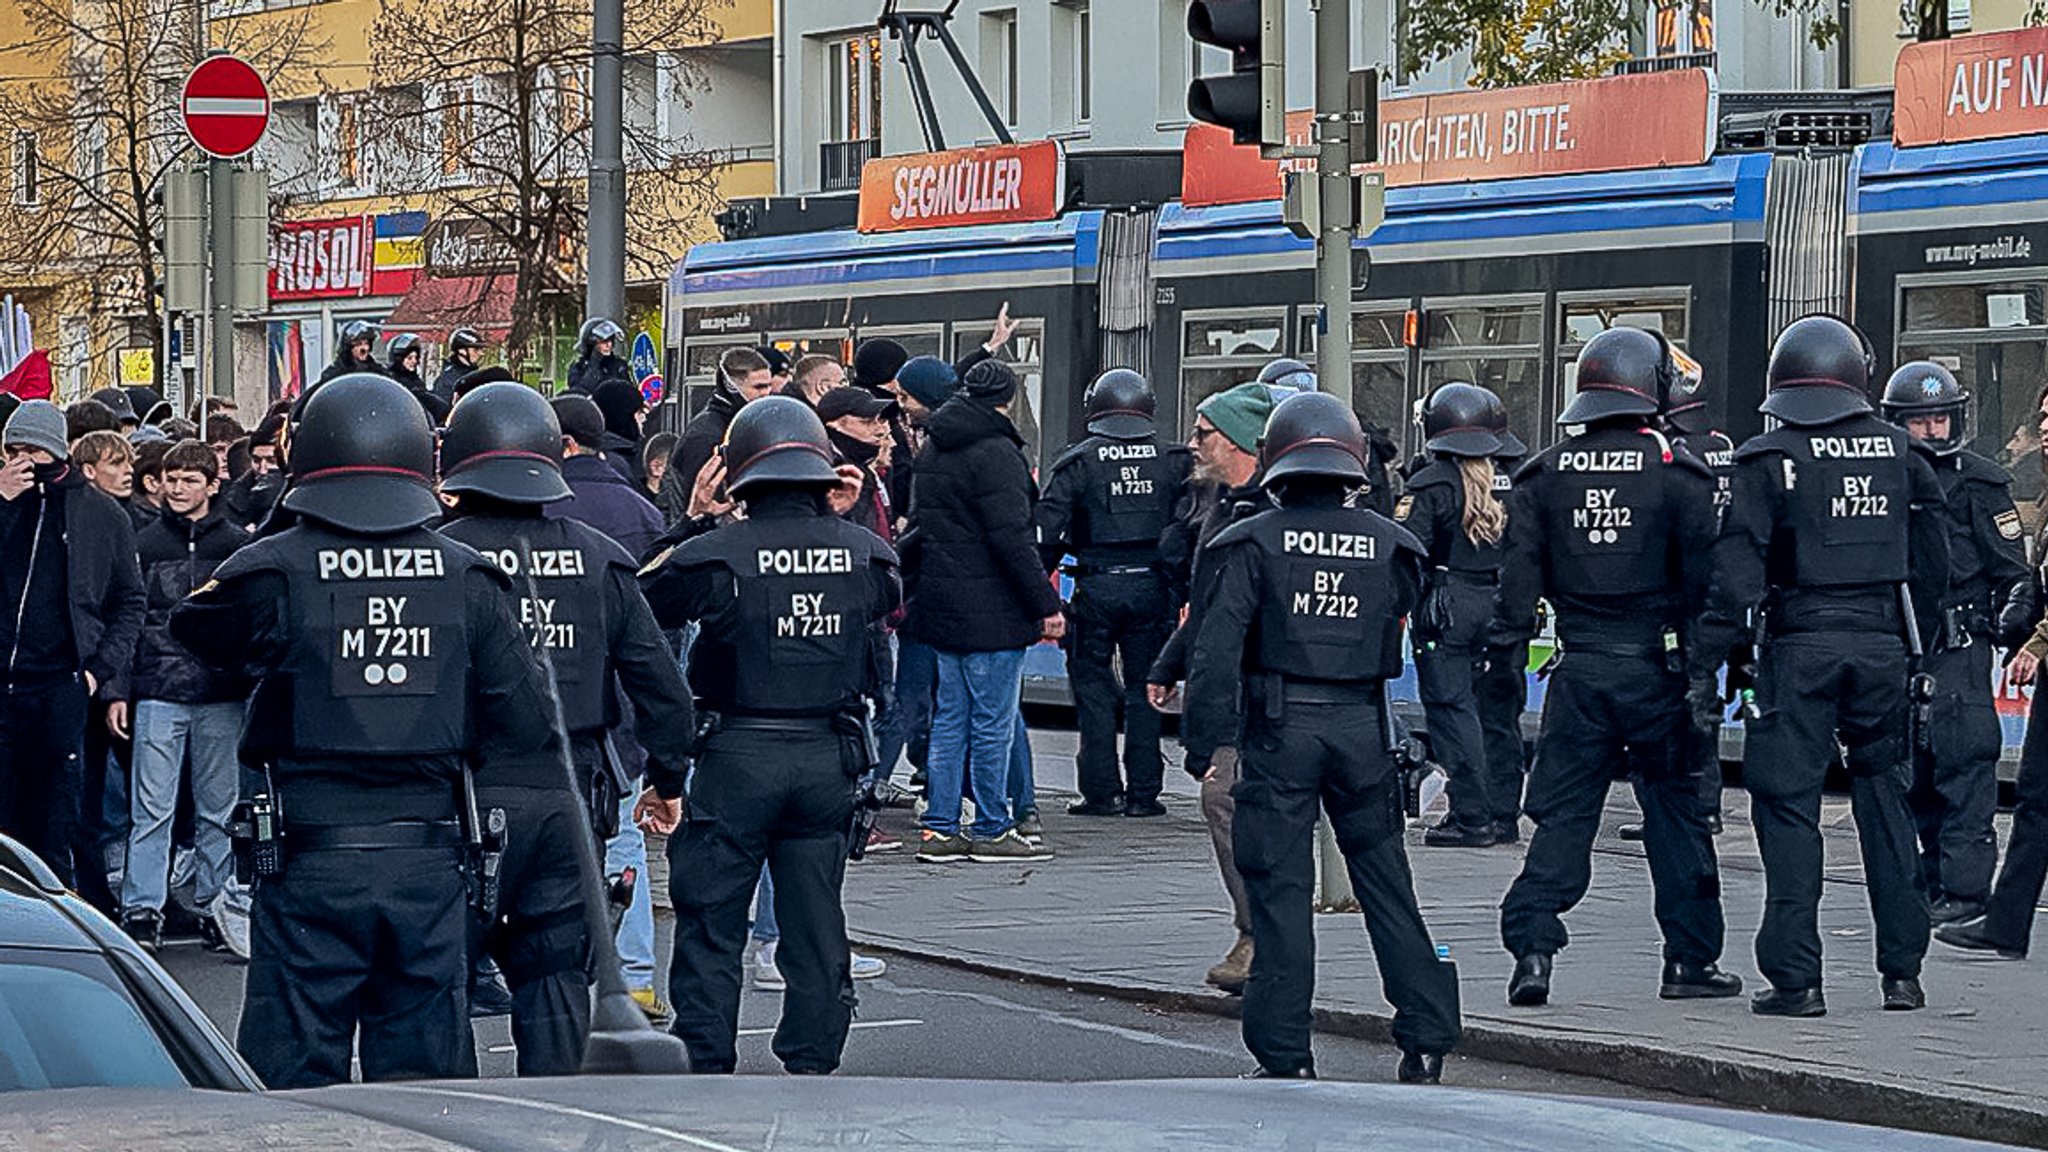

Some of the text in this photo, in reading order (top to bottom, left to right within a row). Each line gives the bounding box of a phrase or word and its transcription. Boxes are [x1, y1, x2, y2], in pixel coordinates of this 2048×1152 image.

[1947, 53, 2048, 116] AUF N
[1502, 103, 1576, 155] BITTE.
[890, 156, 1022, 219] SEGMÜLLER
[1098, 445, 1157, 461] POLIZEI
[1810, 436, 1896, 458] POLIZEI
[1558, 451, 1644, 471] POLIZEI
[1120, 466, 1140, 480] BY
[1111, 480, 1154, 496] M 7213
[1843, 475, 1872, 496] BY
[1585, 488, 1617, 508] BY
[1831, 495, 1888, 517] M 7212
[1573, 507, 1632, 528] M 7212
[1283, 530, 1375, 559] POLIZEI
[318, 548, 444, 579] POLIZEI
[758, 548, 852, 574] POLIZEI
[1314, 570, 1345, 593] BY
[368, 597, 407, 625] BY
[792, 593, 825, 617] BY
[1293, 592, 1359, 618] M 7212
[777, 614, 841, 637] M 7211
[342, 627, 430, 658] M 7211
